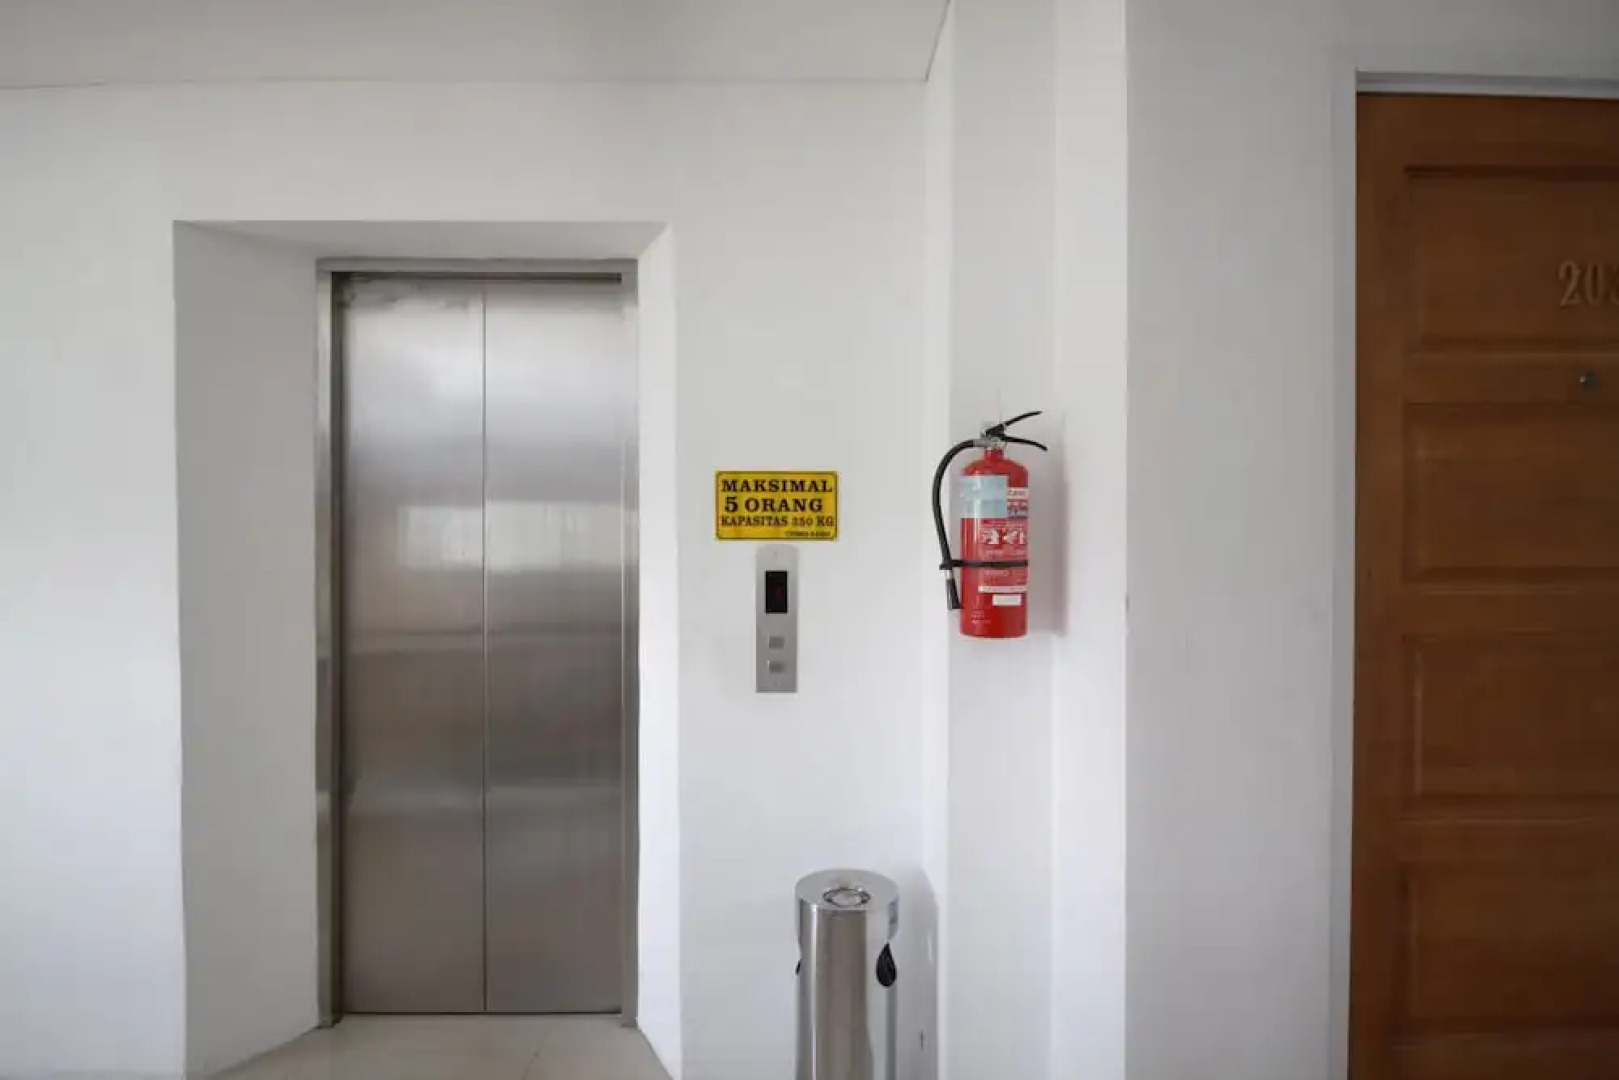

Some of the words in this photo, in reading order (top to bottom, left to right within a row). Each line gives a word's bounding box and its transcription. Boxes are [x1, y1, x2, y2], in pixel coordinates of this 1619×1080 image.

[721, 479, 832, 492] MAKSIMAL
[724, 496, 739, 512] 5
[744, 498, 823, 512] ORANG
[721, 516, 788, 526] KAPASITAS
[816, 516, 835, 526] KG
